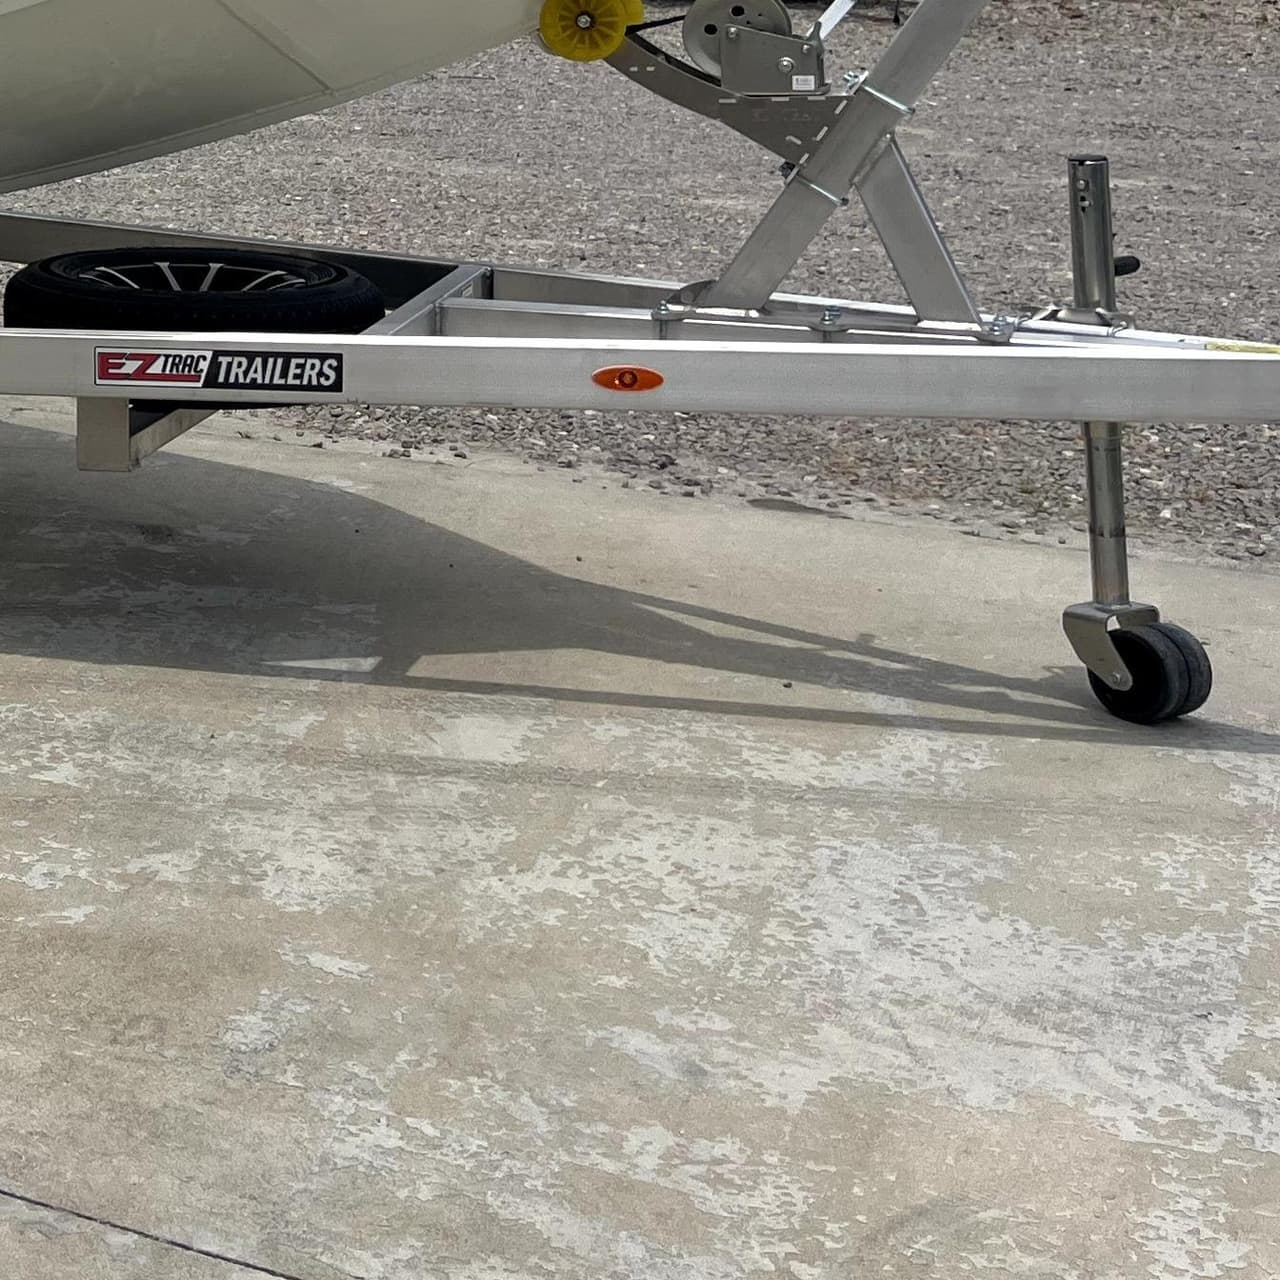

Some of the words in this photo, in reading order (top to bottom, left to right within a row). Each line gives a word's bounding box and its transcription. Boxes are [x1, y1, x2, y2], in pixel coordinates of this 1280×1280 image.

[97, 352, 161, 381] EZ
[161, 354, 207, 375] TRAC
[217, 356, 338, 387] TRAILERS
